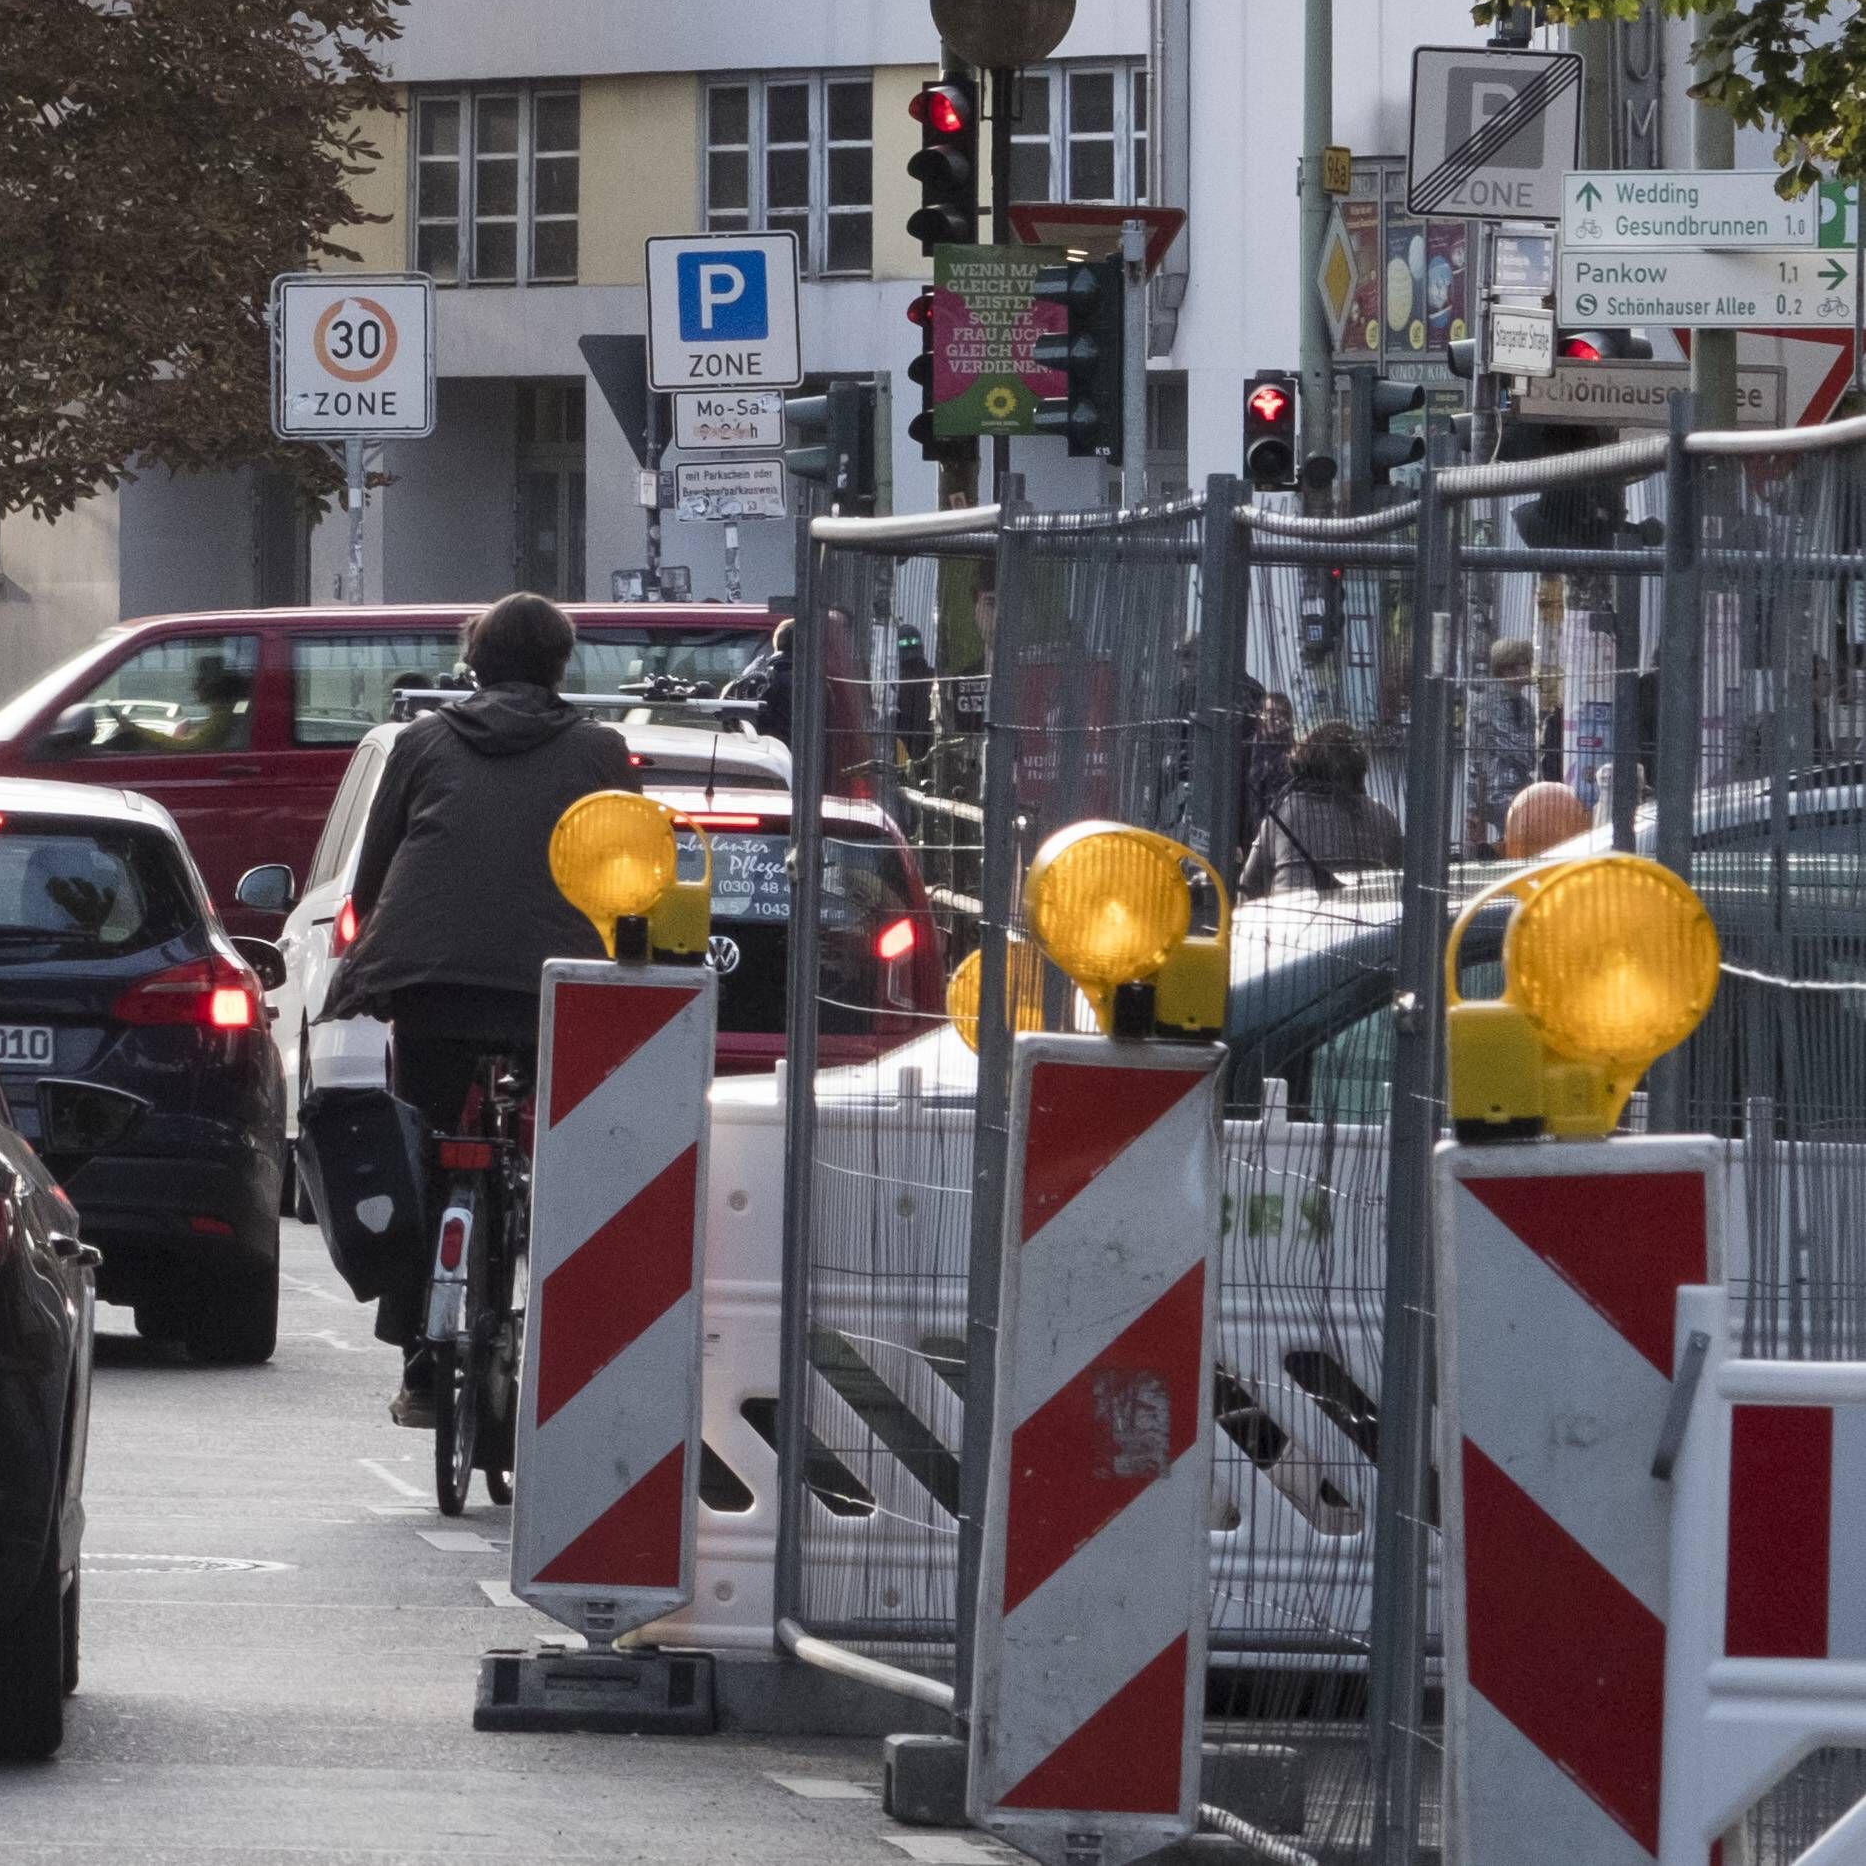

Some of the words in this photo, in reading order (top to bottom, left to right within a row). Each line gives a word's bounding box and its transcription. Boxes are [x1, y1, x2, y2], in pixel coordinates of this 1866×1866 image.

[1327, 162, 1346, 184] 96a
[1450, 180, 1533, 208] ZONE
[1616, 183, 1699, 208] Wedding
[1616, 215, 1768, 236] Gesundbrunnen
[949, 263, 1005, 277] WENN
[1577, 262, 1668, 283] Pankow
[947, 280, 1016, 293] GLEICH
[699, 264, 746, 329] P
[964, 296, 1038, 311] LEISTET,
[1607, 297, 1710, 316] Schönhauser
[1716, 297, 1756, 315] Allee
[969, 312, 1033, 325] SOLLTE
[331, 319, 381, 359] 30
[953, 328, 997, 341] FRAU
[946, 344, 1012, 357] GLEICH
[689, 352, 763, 377] ZONE
[949, 360, 1052, 373] VERDIENEN.
[314, 392, 397, 416] ZONE
[686, 470, 700, 481] mit
[704, 469, 751, 480] Parkschein
[754, 468, 773, 478] oder
[719, 881, 755, 894] (030)
[760, 882, 779, 894] 48
[754, 902, 790, 915] 1043
